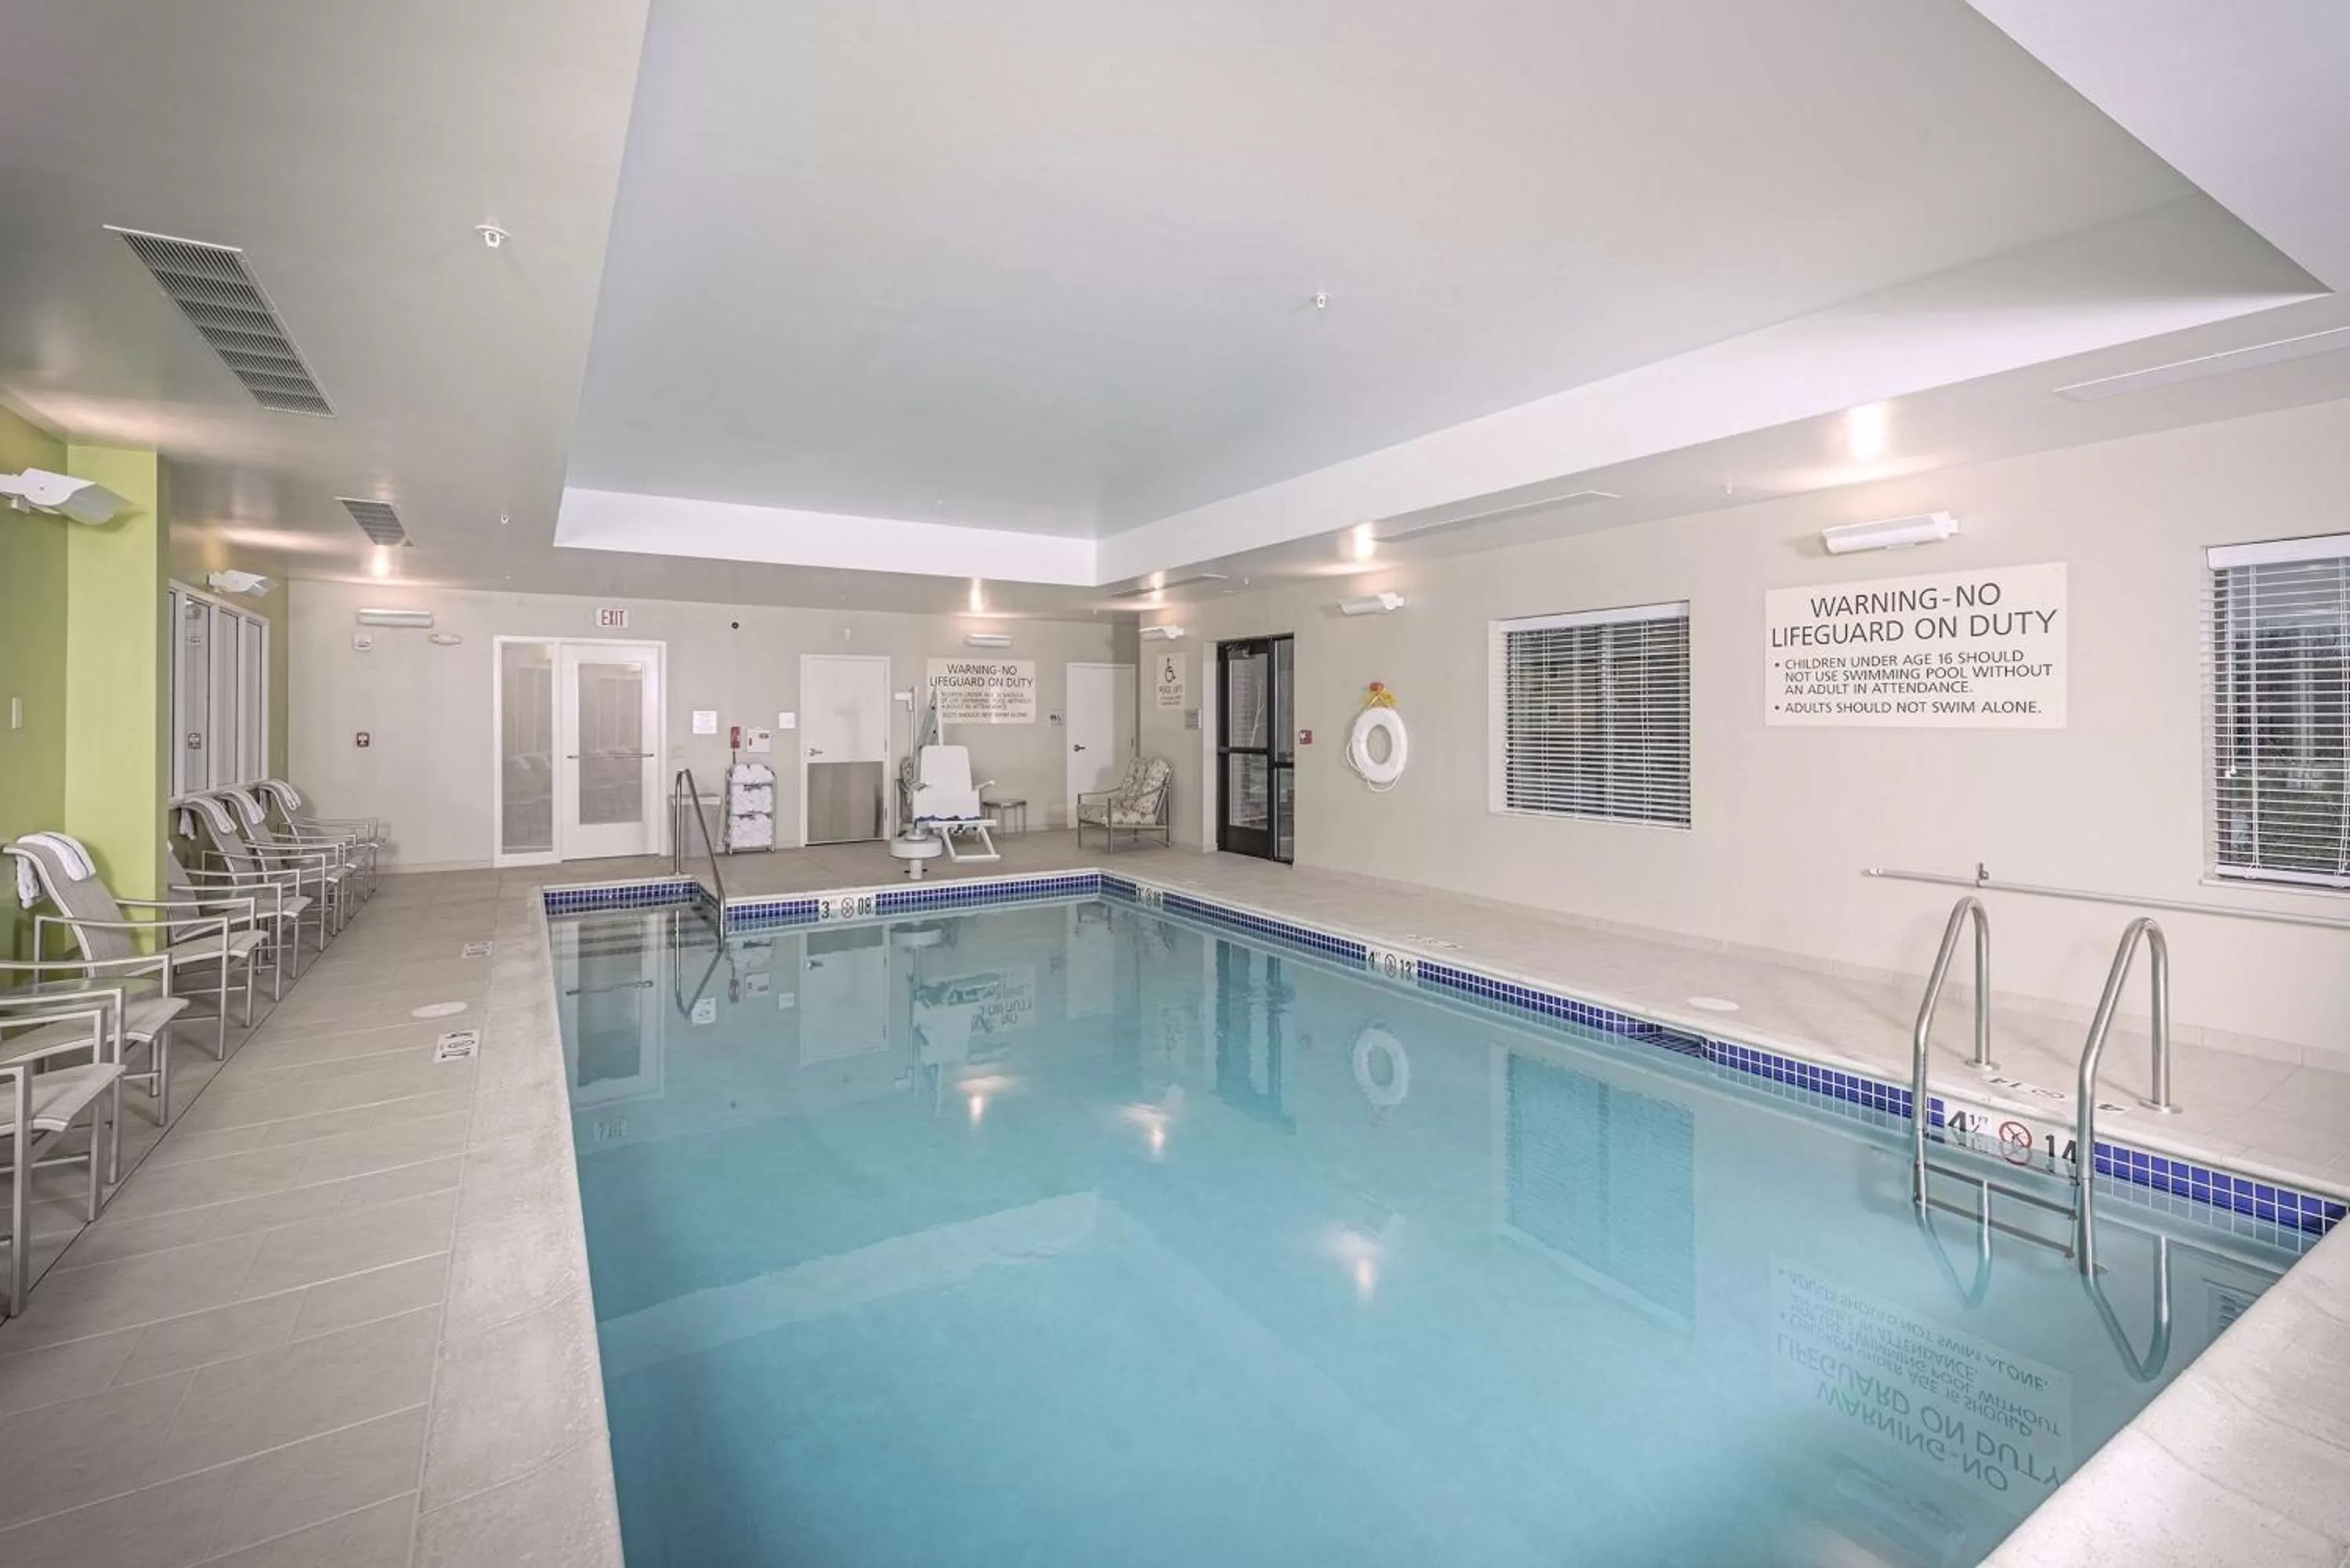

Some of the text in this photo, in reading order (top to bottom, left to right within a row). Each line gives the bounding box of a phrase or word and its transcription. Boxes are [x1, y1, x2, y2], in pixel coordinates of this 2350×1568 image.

[1810, 583, 2001, 617] WARNING-NO
[601, 609, 624, 627] EXIT
[1772, 609, 2057, 647] LIFEGUARD ON DUTY
[1784, 649, 2024, 670] CHILDREN UNDER AGE 16 SHOULD
[1784, 663, 2053, 682] NOT USE SWIMMING POOL WITHOUT
[929, 676, 1034, 688] LIFEGUARD ON DUTY
[1784, 681, 1974, 695] AN ADULT IN ATTENDANCE.
[1784, 700, 2043, 714] ADULTS SHOULD NOT SWIM ALONE.
